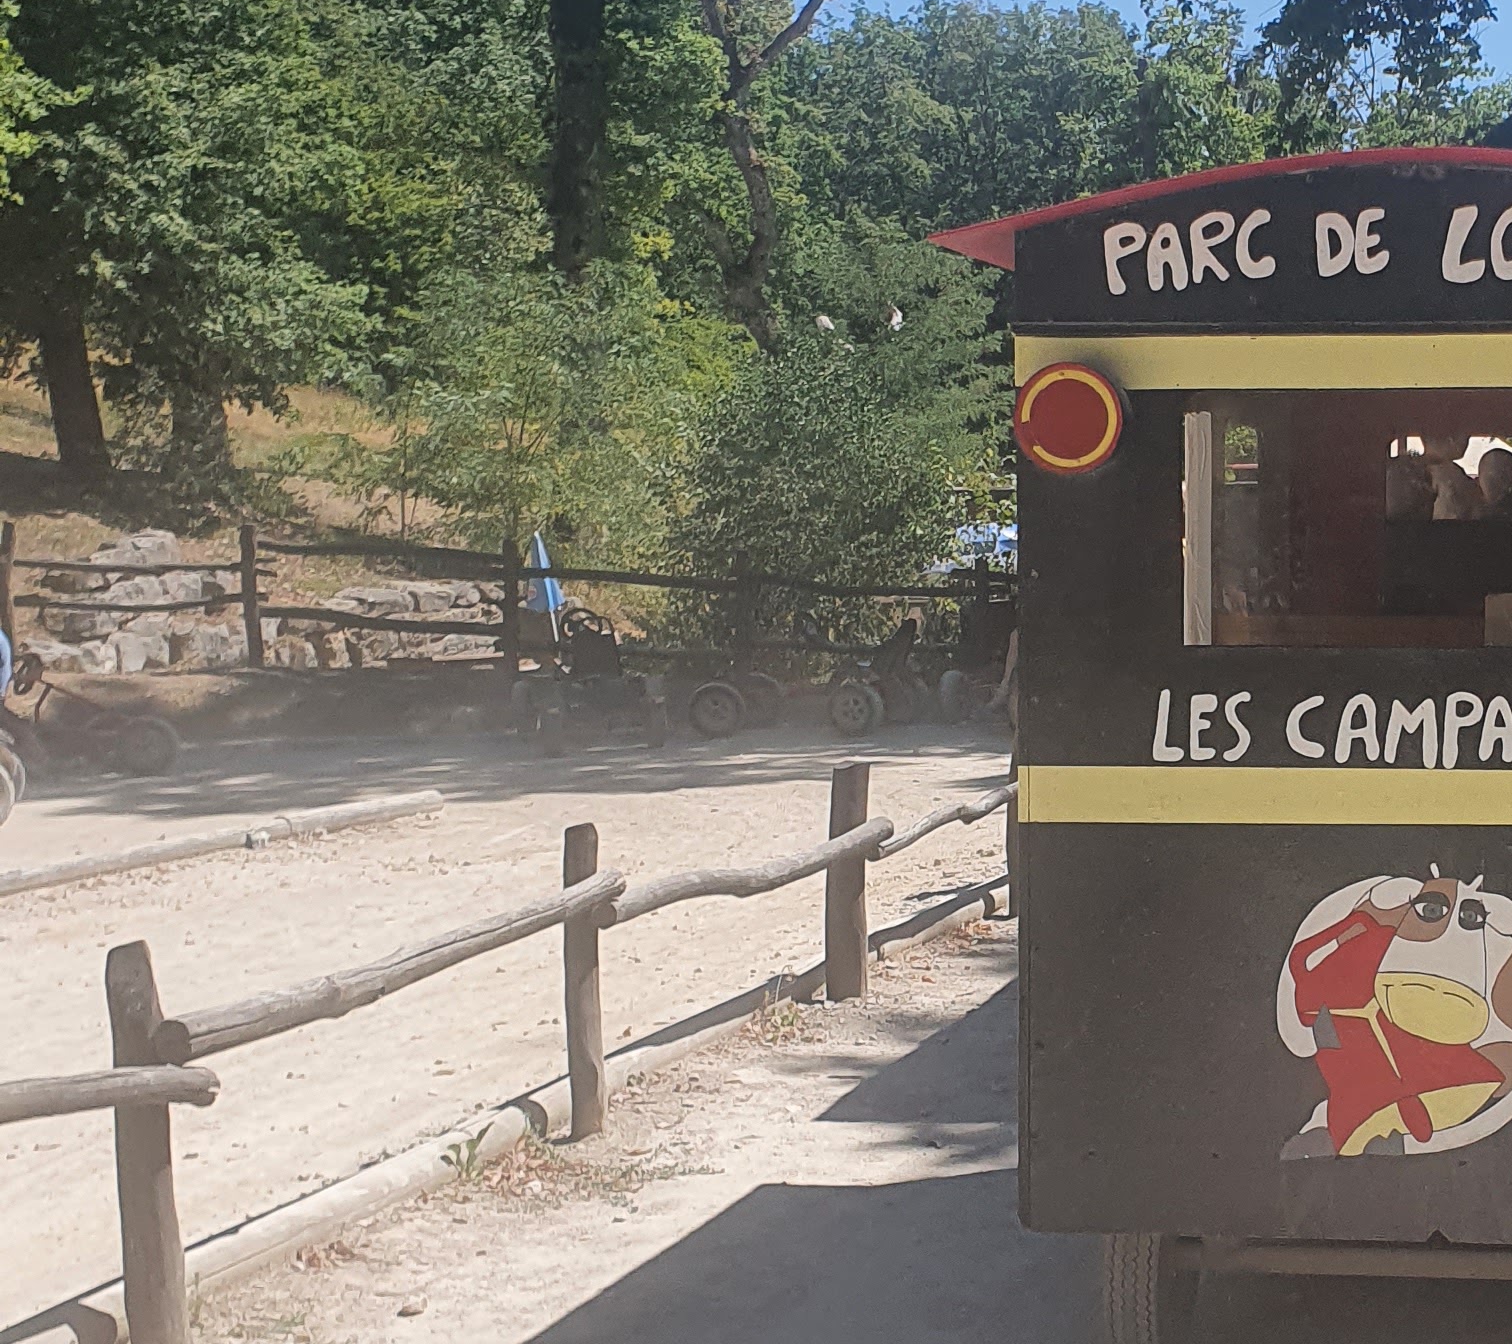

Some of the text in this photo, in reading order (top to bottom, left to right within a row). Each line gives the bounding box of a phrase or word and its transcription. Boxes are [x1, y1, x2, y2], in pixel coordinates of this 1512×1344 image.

[1102, 207, 1277, 296] PARC
[1314, 207, 1391, 279] DE
[1151, 687, 1253, 763] LES
